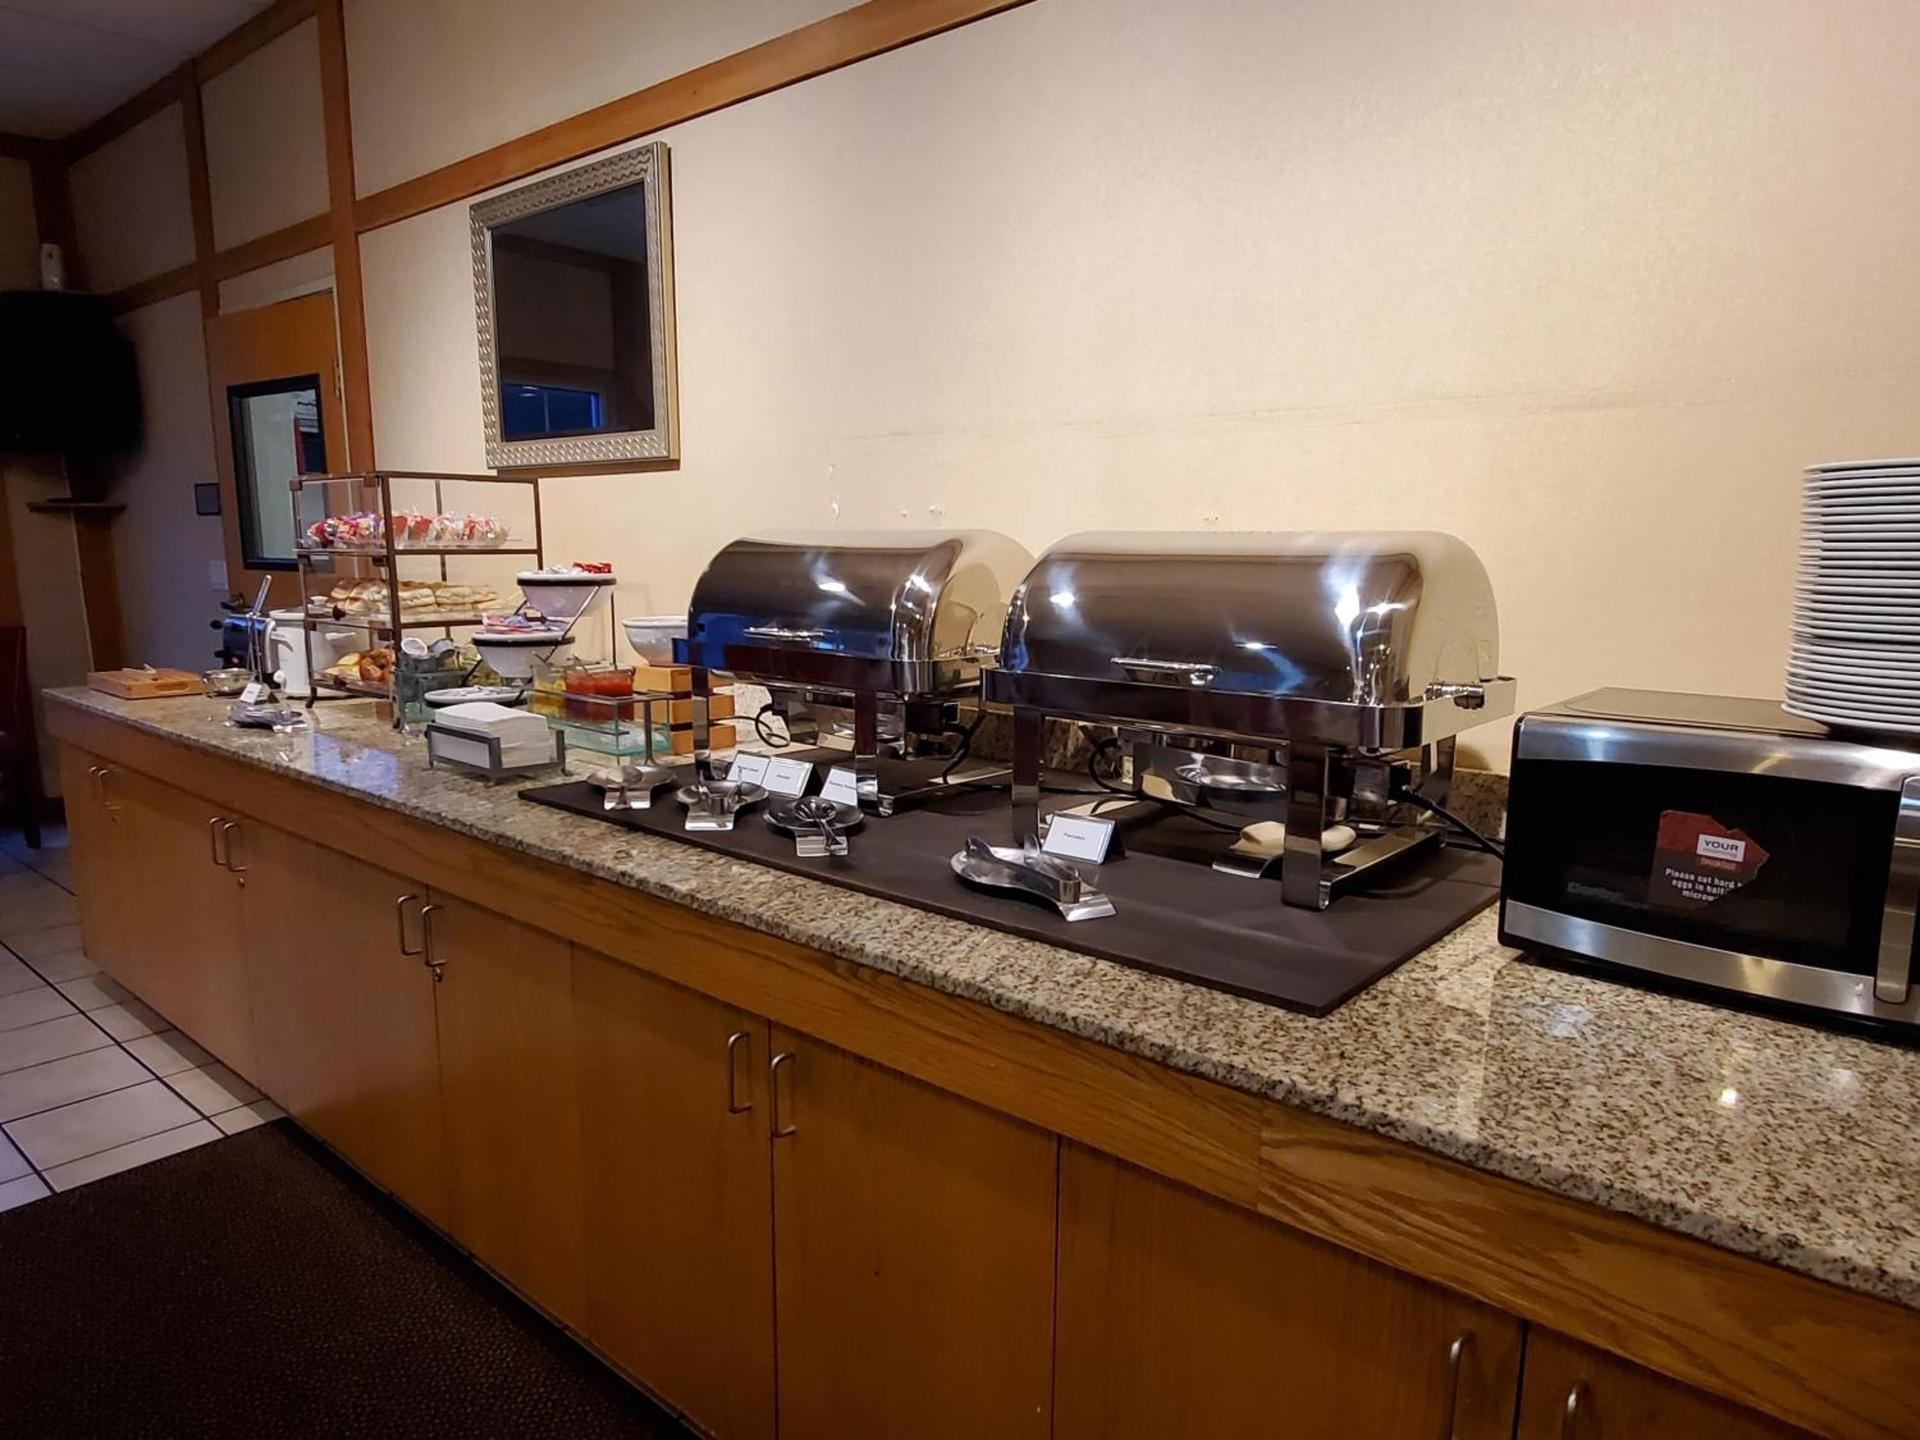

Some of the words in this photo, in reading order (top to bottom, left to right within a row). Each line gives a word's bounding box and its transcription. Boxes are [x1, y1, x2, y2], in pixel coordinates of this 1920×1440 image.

[1704, 839, 1739, 852] YOUR
[1665, 868, 1695, 881] Please
[1714, 877, 1736, 889] hard
[1671, 879, 1692, 889] eggs
